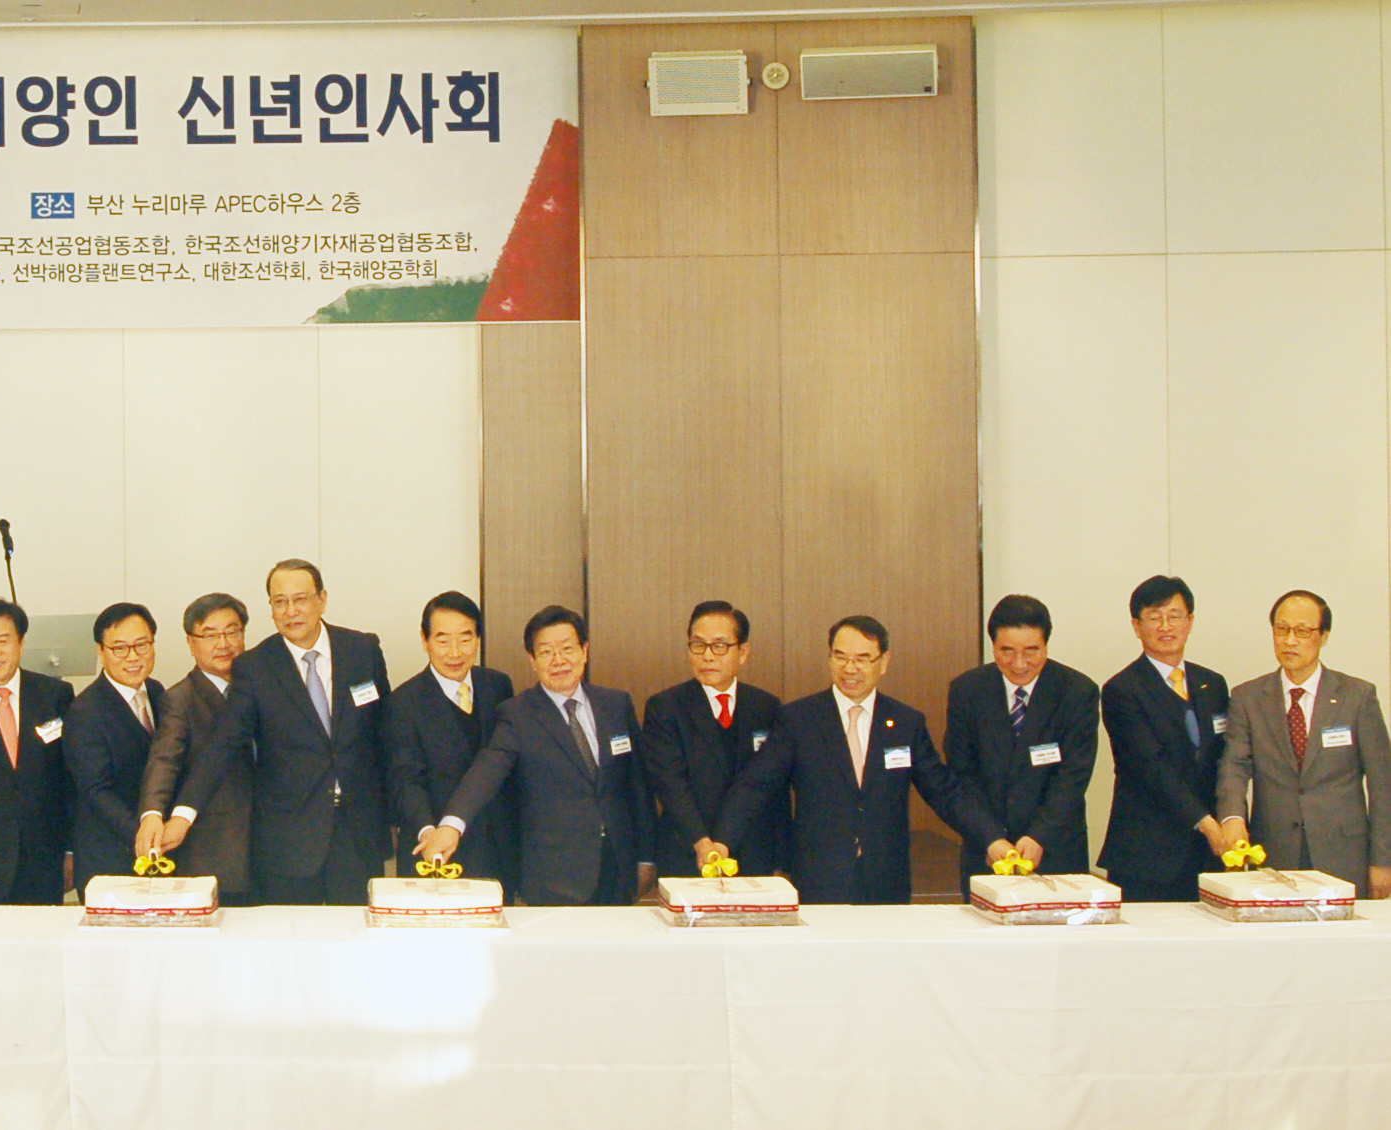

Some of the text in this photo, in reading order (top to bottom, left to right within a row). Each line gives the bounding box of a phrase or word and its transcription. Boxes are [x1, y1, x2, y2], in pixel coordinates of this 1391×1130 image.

[177, 70, 501, 145] 신년인사회
[33, 191, 362, 217] 장소 부산 누리마루 APEC하우스 2층
[185, 232, 478, 256] 한국조선해양기자재공업협동조합,
[12, 262, 196, 283] 선박해양플랜트연구소,
[204, 260, 311, 282] 대한조선학회,
[318, 259, 439, 281] 한국해양공학회
